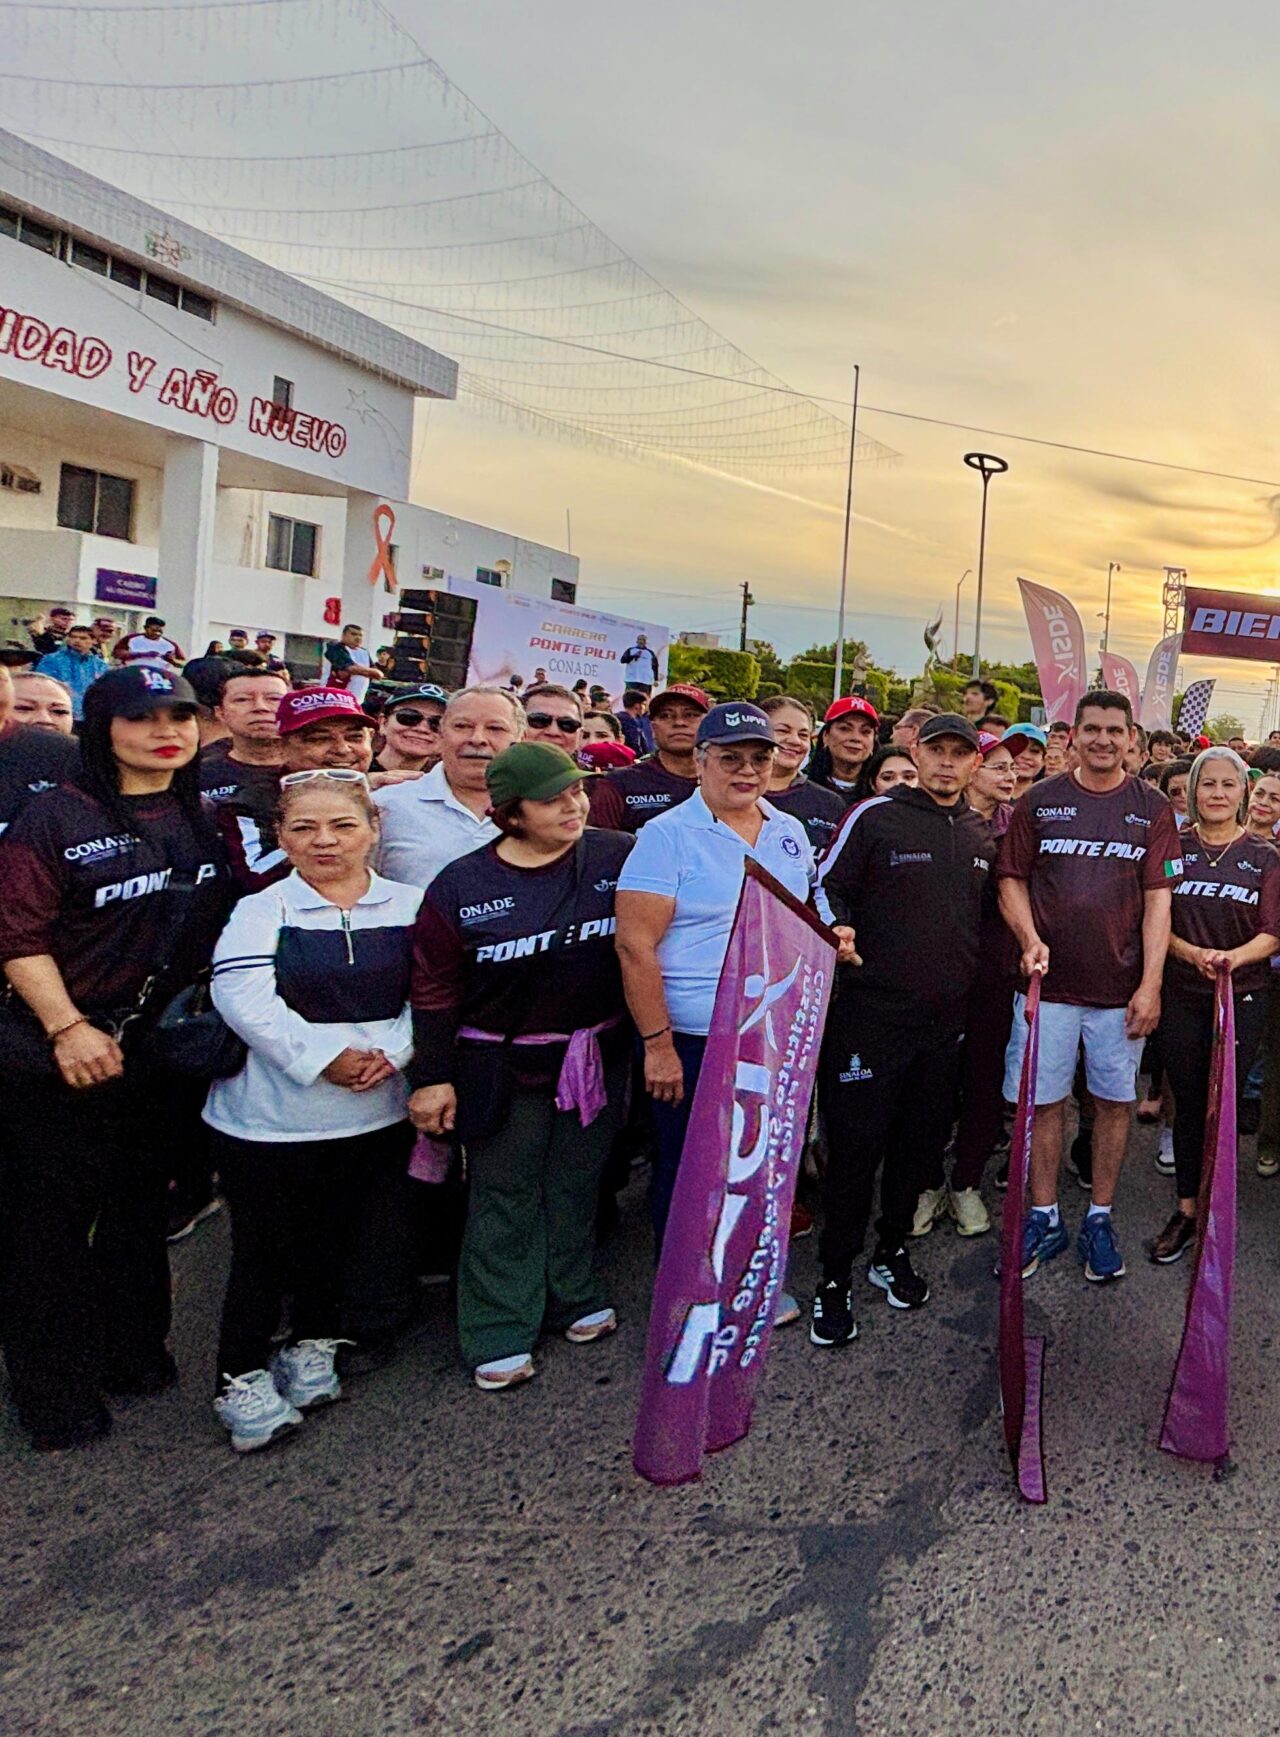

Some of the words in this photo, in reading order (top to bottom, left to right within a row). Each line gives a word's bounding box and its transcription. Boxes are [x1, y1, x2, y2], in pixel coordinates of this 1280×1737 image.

[0, 306, 112, 379] IDAD
[128, 351, 156, 393] Y
[158, 367, 238, 424] AÑO
[249, 397, 347, 458] NUEVO
[541, 621, 608, 643] CARRERA
[529, 637, 582, 655] PONTE
[583, 645, 617, 661] PILA
[549, 657, 600, 678] CONADE
[140, 668, 173, 690] LA
[290, 691, 355, 708] CONADE
[626, 794, 671, 804] CONADE
[1036, 806, 1078, 818] CONADE
[1039, 838, 1104, 858] PONTE
[1103, 841, 1147, 862] PILA
[1219, 884, 1259, 906] PILA
[839, 1068, 873, 1080] SINALOA
